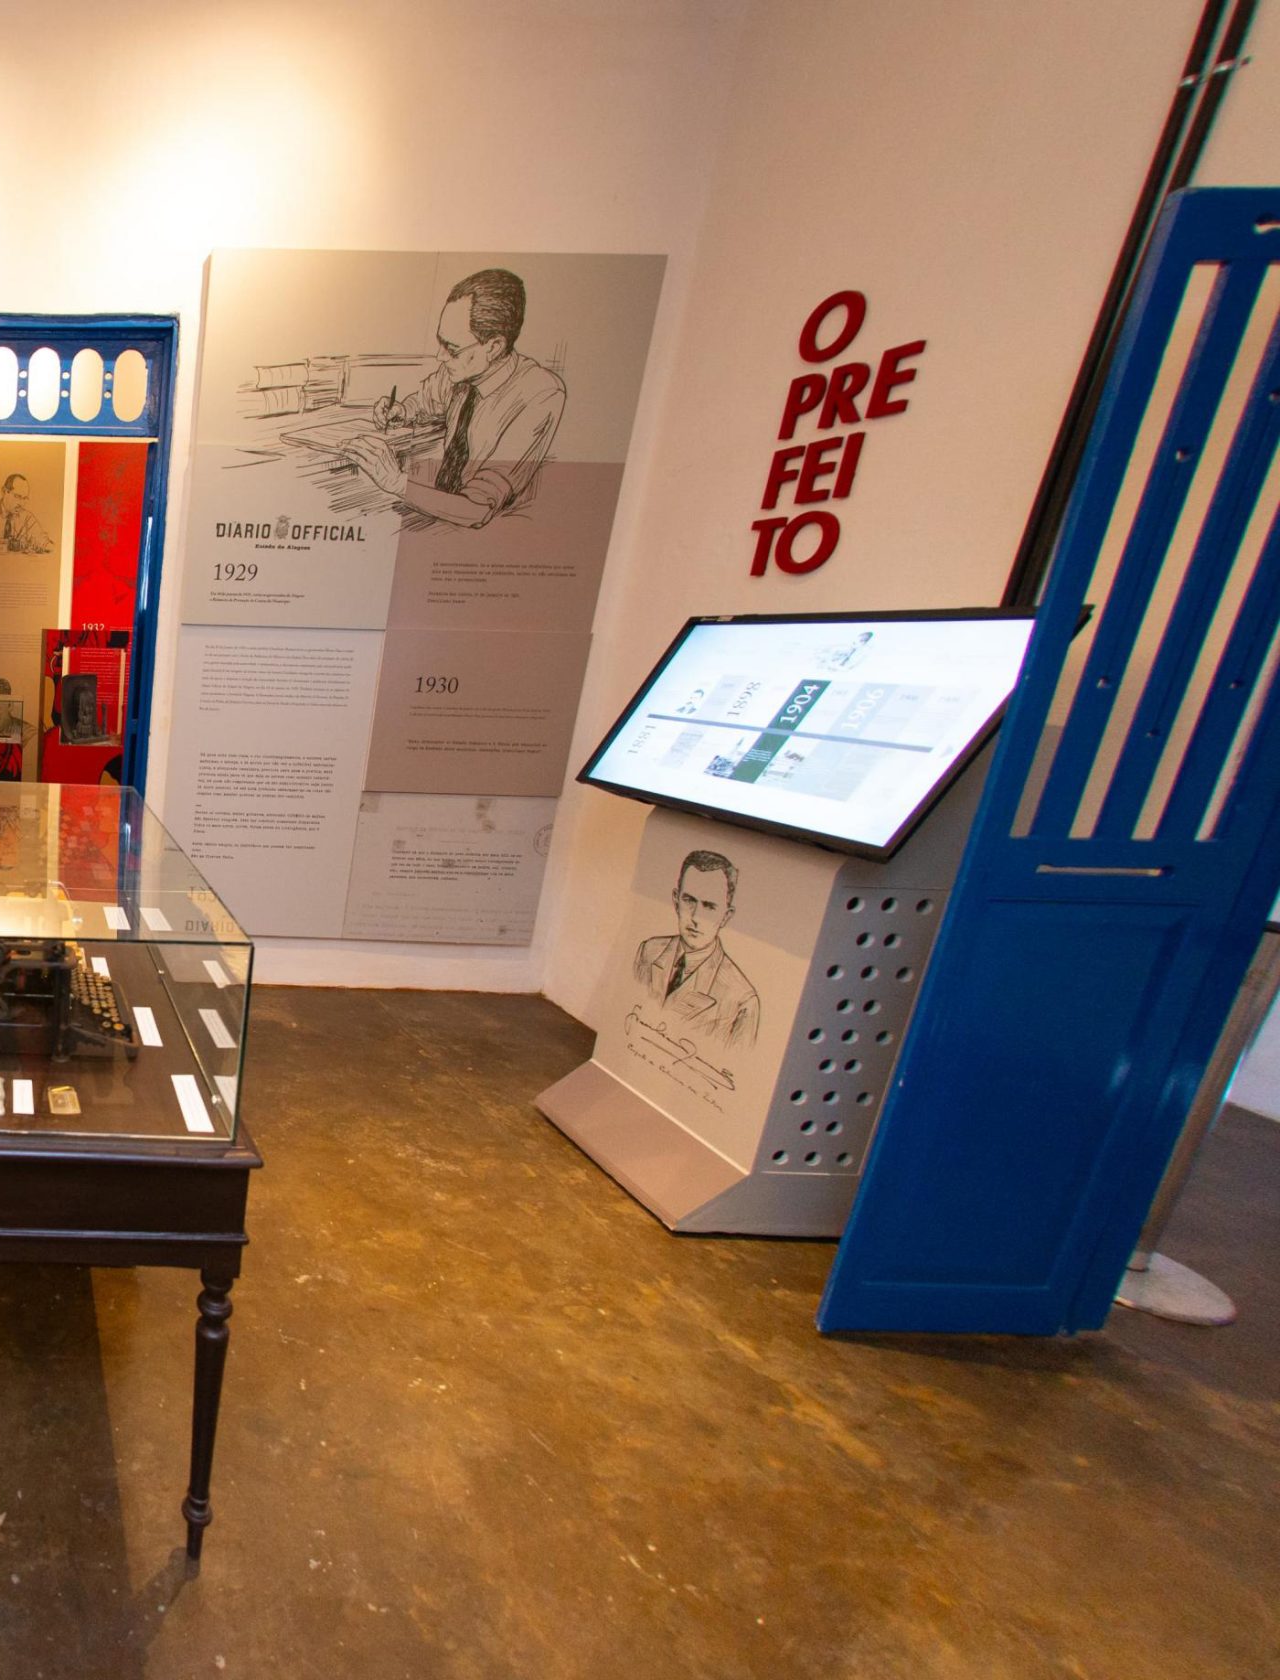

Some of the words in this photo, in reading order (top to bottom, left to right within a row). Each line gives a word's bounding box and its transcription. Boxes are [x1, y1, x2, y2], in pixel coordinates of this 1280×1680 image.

[798, 290, 867, 363] O
[778, 339, 927, 440] PRE
[760, 431, 866, 510] FEI
[291, 524, 366, 541] OFFICIAL
[750, 510, 840, 577] TO
[213, 563, 258, 581] 1929
[414, 676, 459, 694] 1930
[780, 684, 821, 725] 1904
